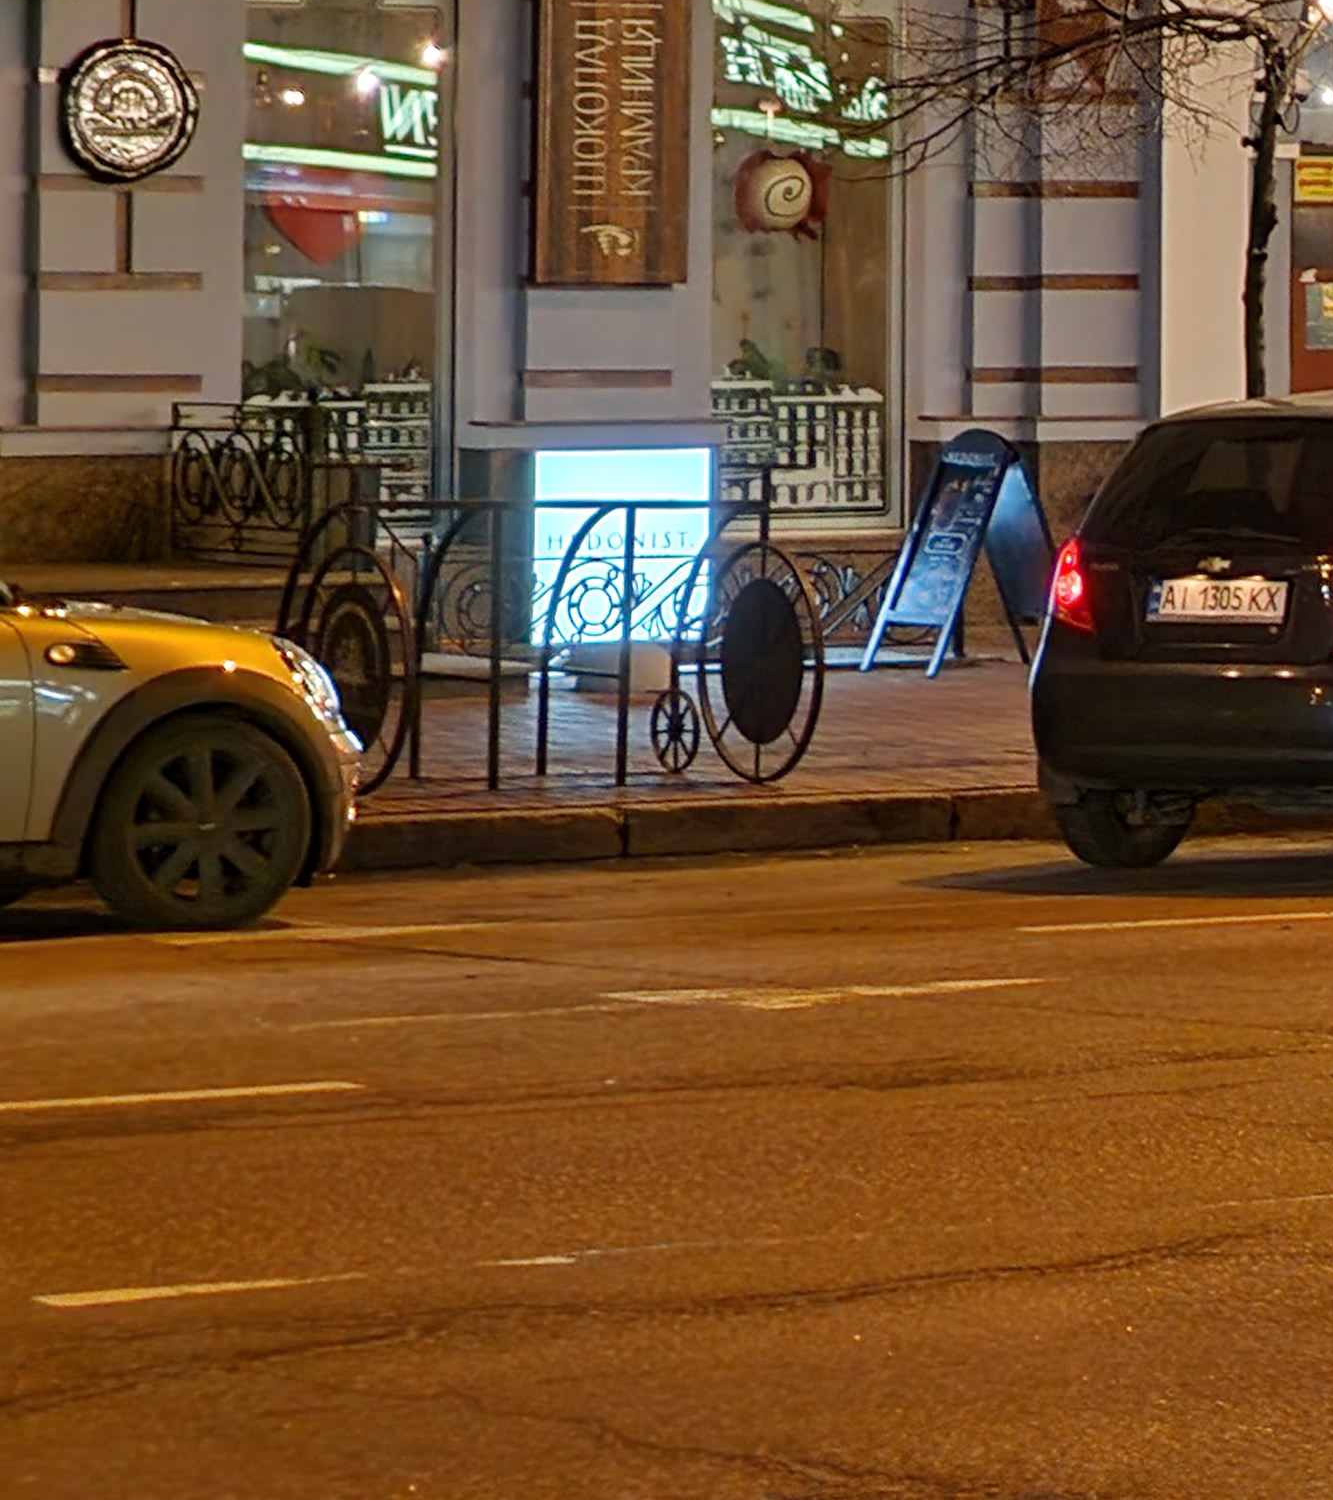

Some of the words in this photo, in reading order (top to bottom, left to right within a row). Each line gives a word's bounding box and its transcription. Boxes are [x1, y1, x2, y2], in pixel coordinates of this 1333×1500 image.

[572, 18, 614, 195] ШОКОЛАД
[619, 17, 663, 196] КРАМНИЦЯ
[548, 530, 695, 551] HDONIST.
[1162, 584, 1189, 610] AI
[1199, 586, 1243, 611] 1305
[1249, 586, 1281, 612] KX
